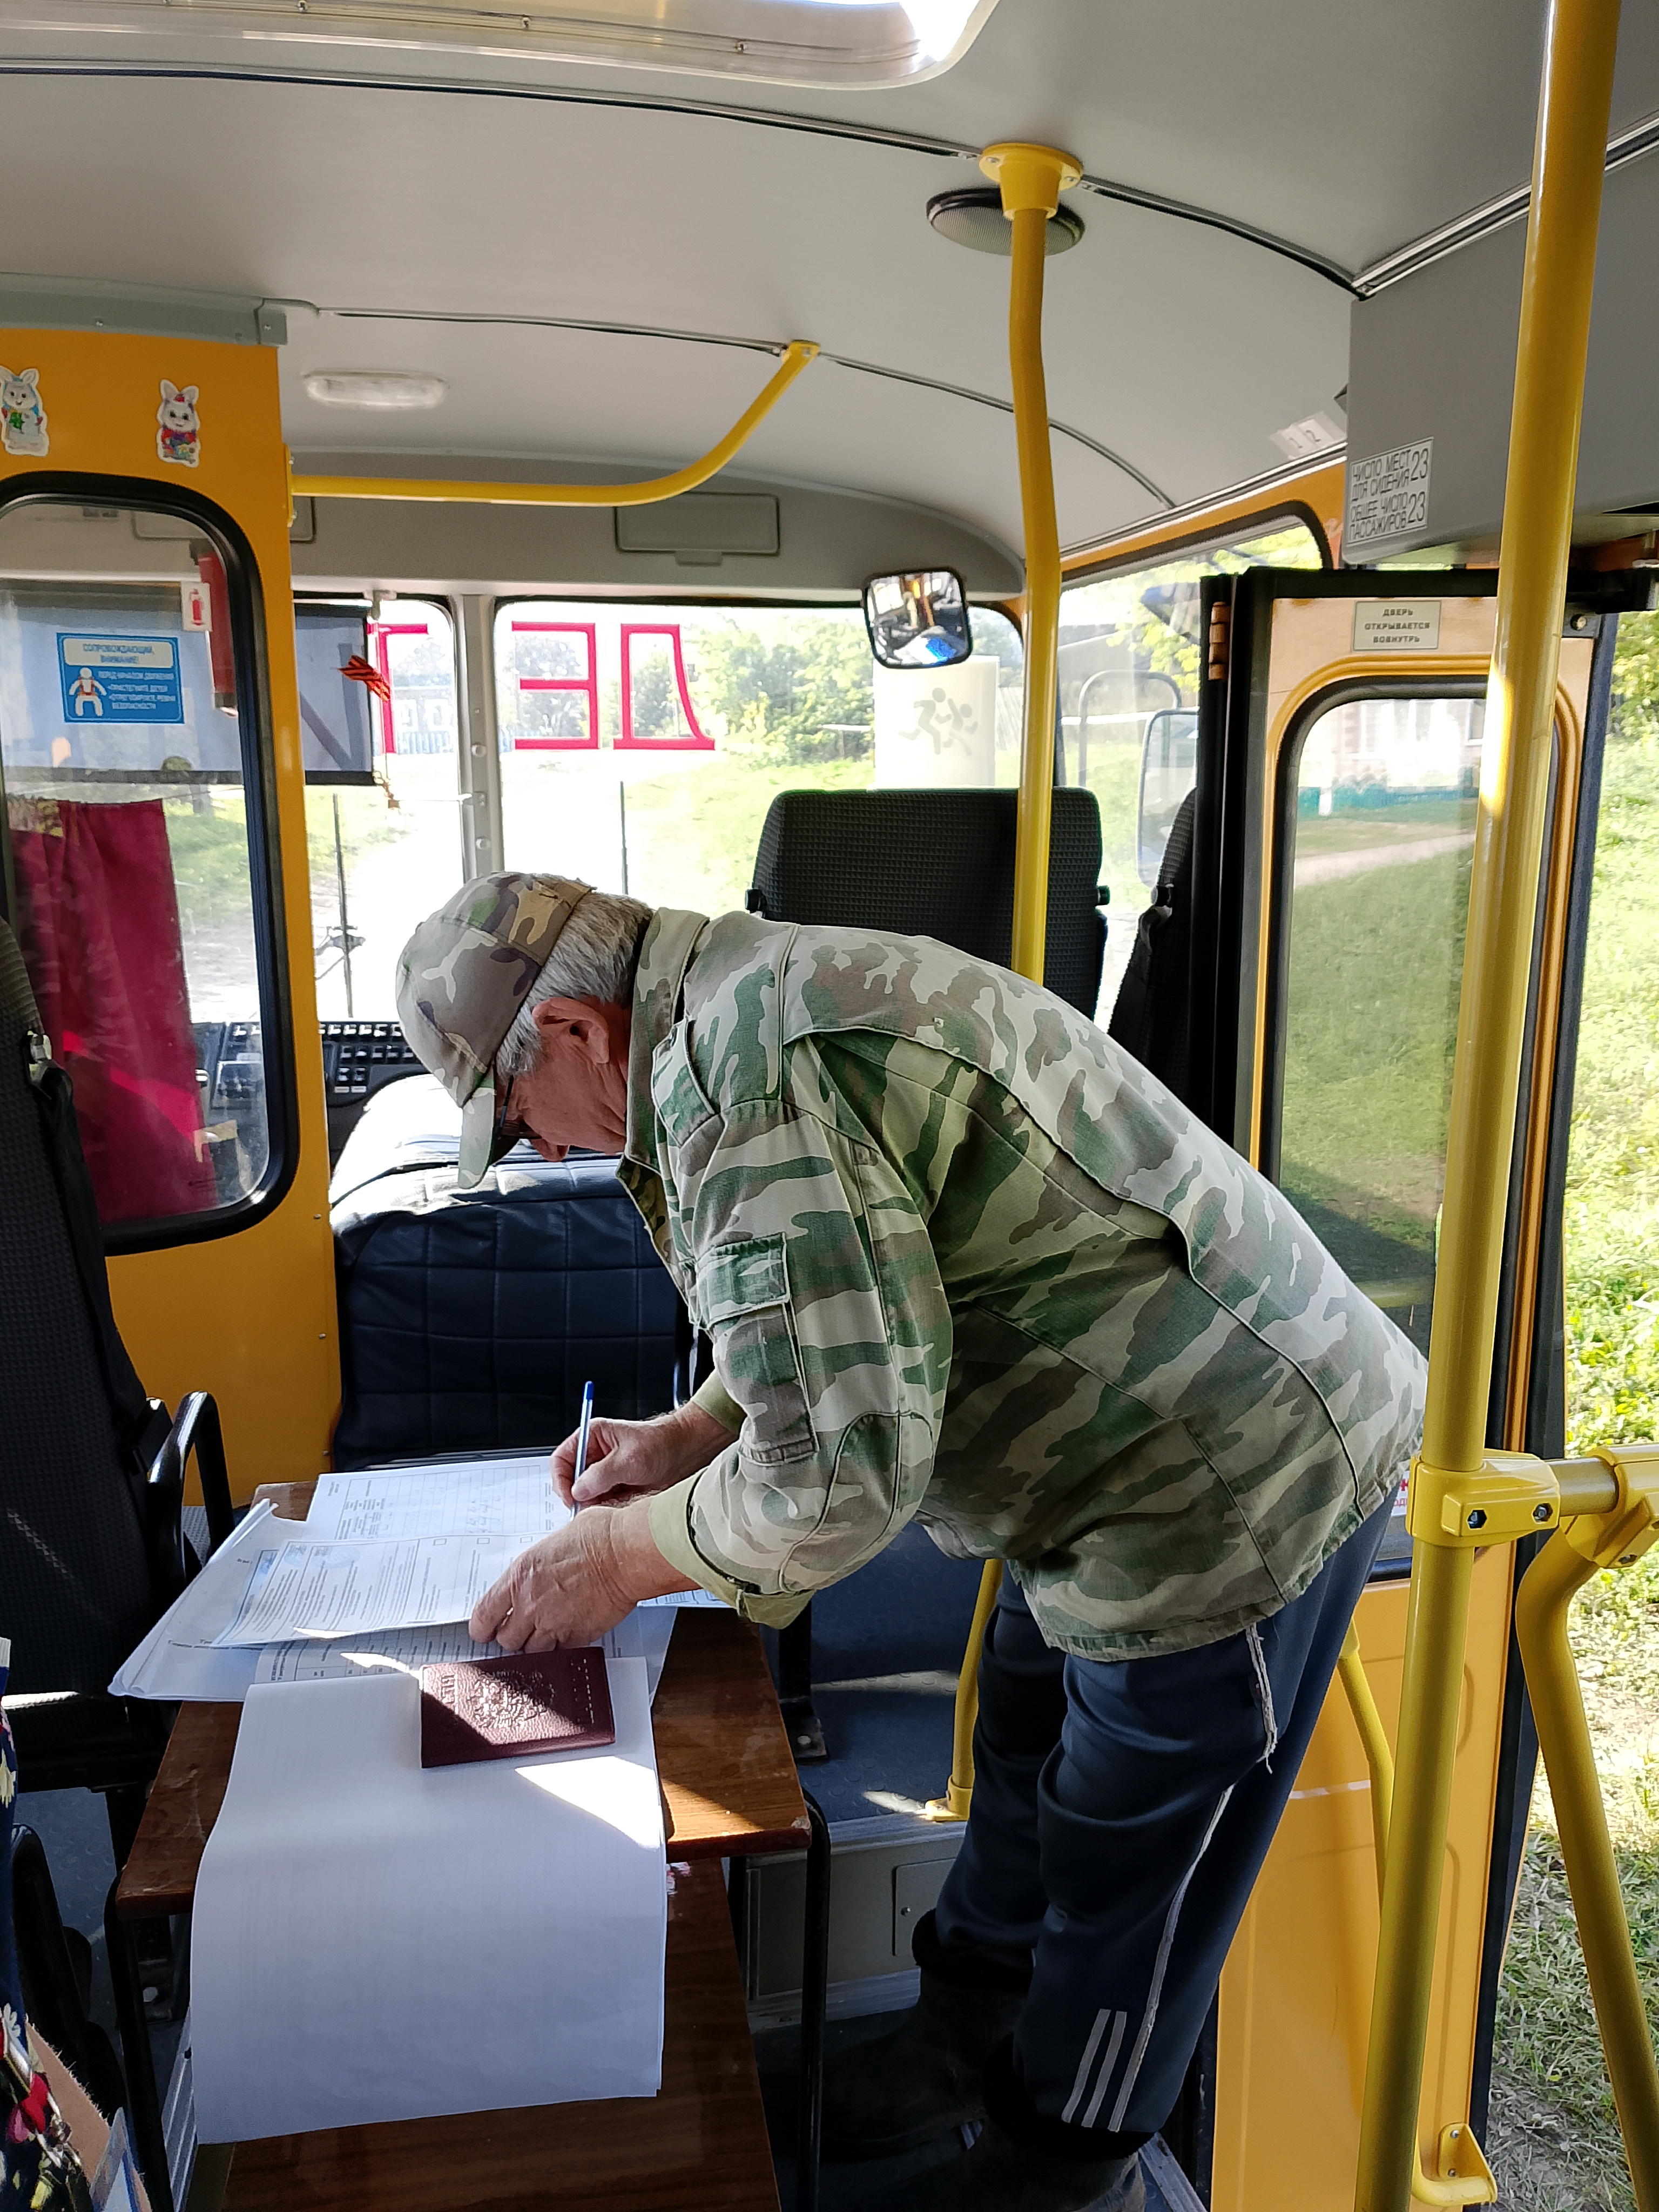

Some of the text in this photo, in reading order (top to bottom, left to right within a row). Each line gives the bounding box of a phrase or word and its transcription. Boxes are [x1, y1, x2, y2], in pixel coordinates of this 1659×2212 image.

[1353, 449, 1411, 482] ЧИСЛО МЕСТ
[1410, 448, 1429, 481] 23
[1350, 491, 1426, 539] ПАССАЖИРОВ 23
[1380, 491, 1408, 514] ЧИСЛО
[1364, 622, 1431, 630] ОТКРЫВАЕТСЯ
[1382, 608, 1414, 617] ДВЕРЬ
